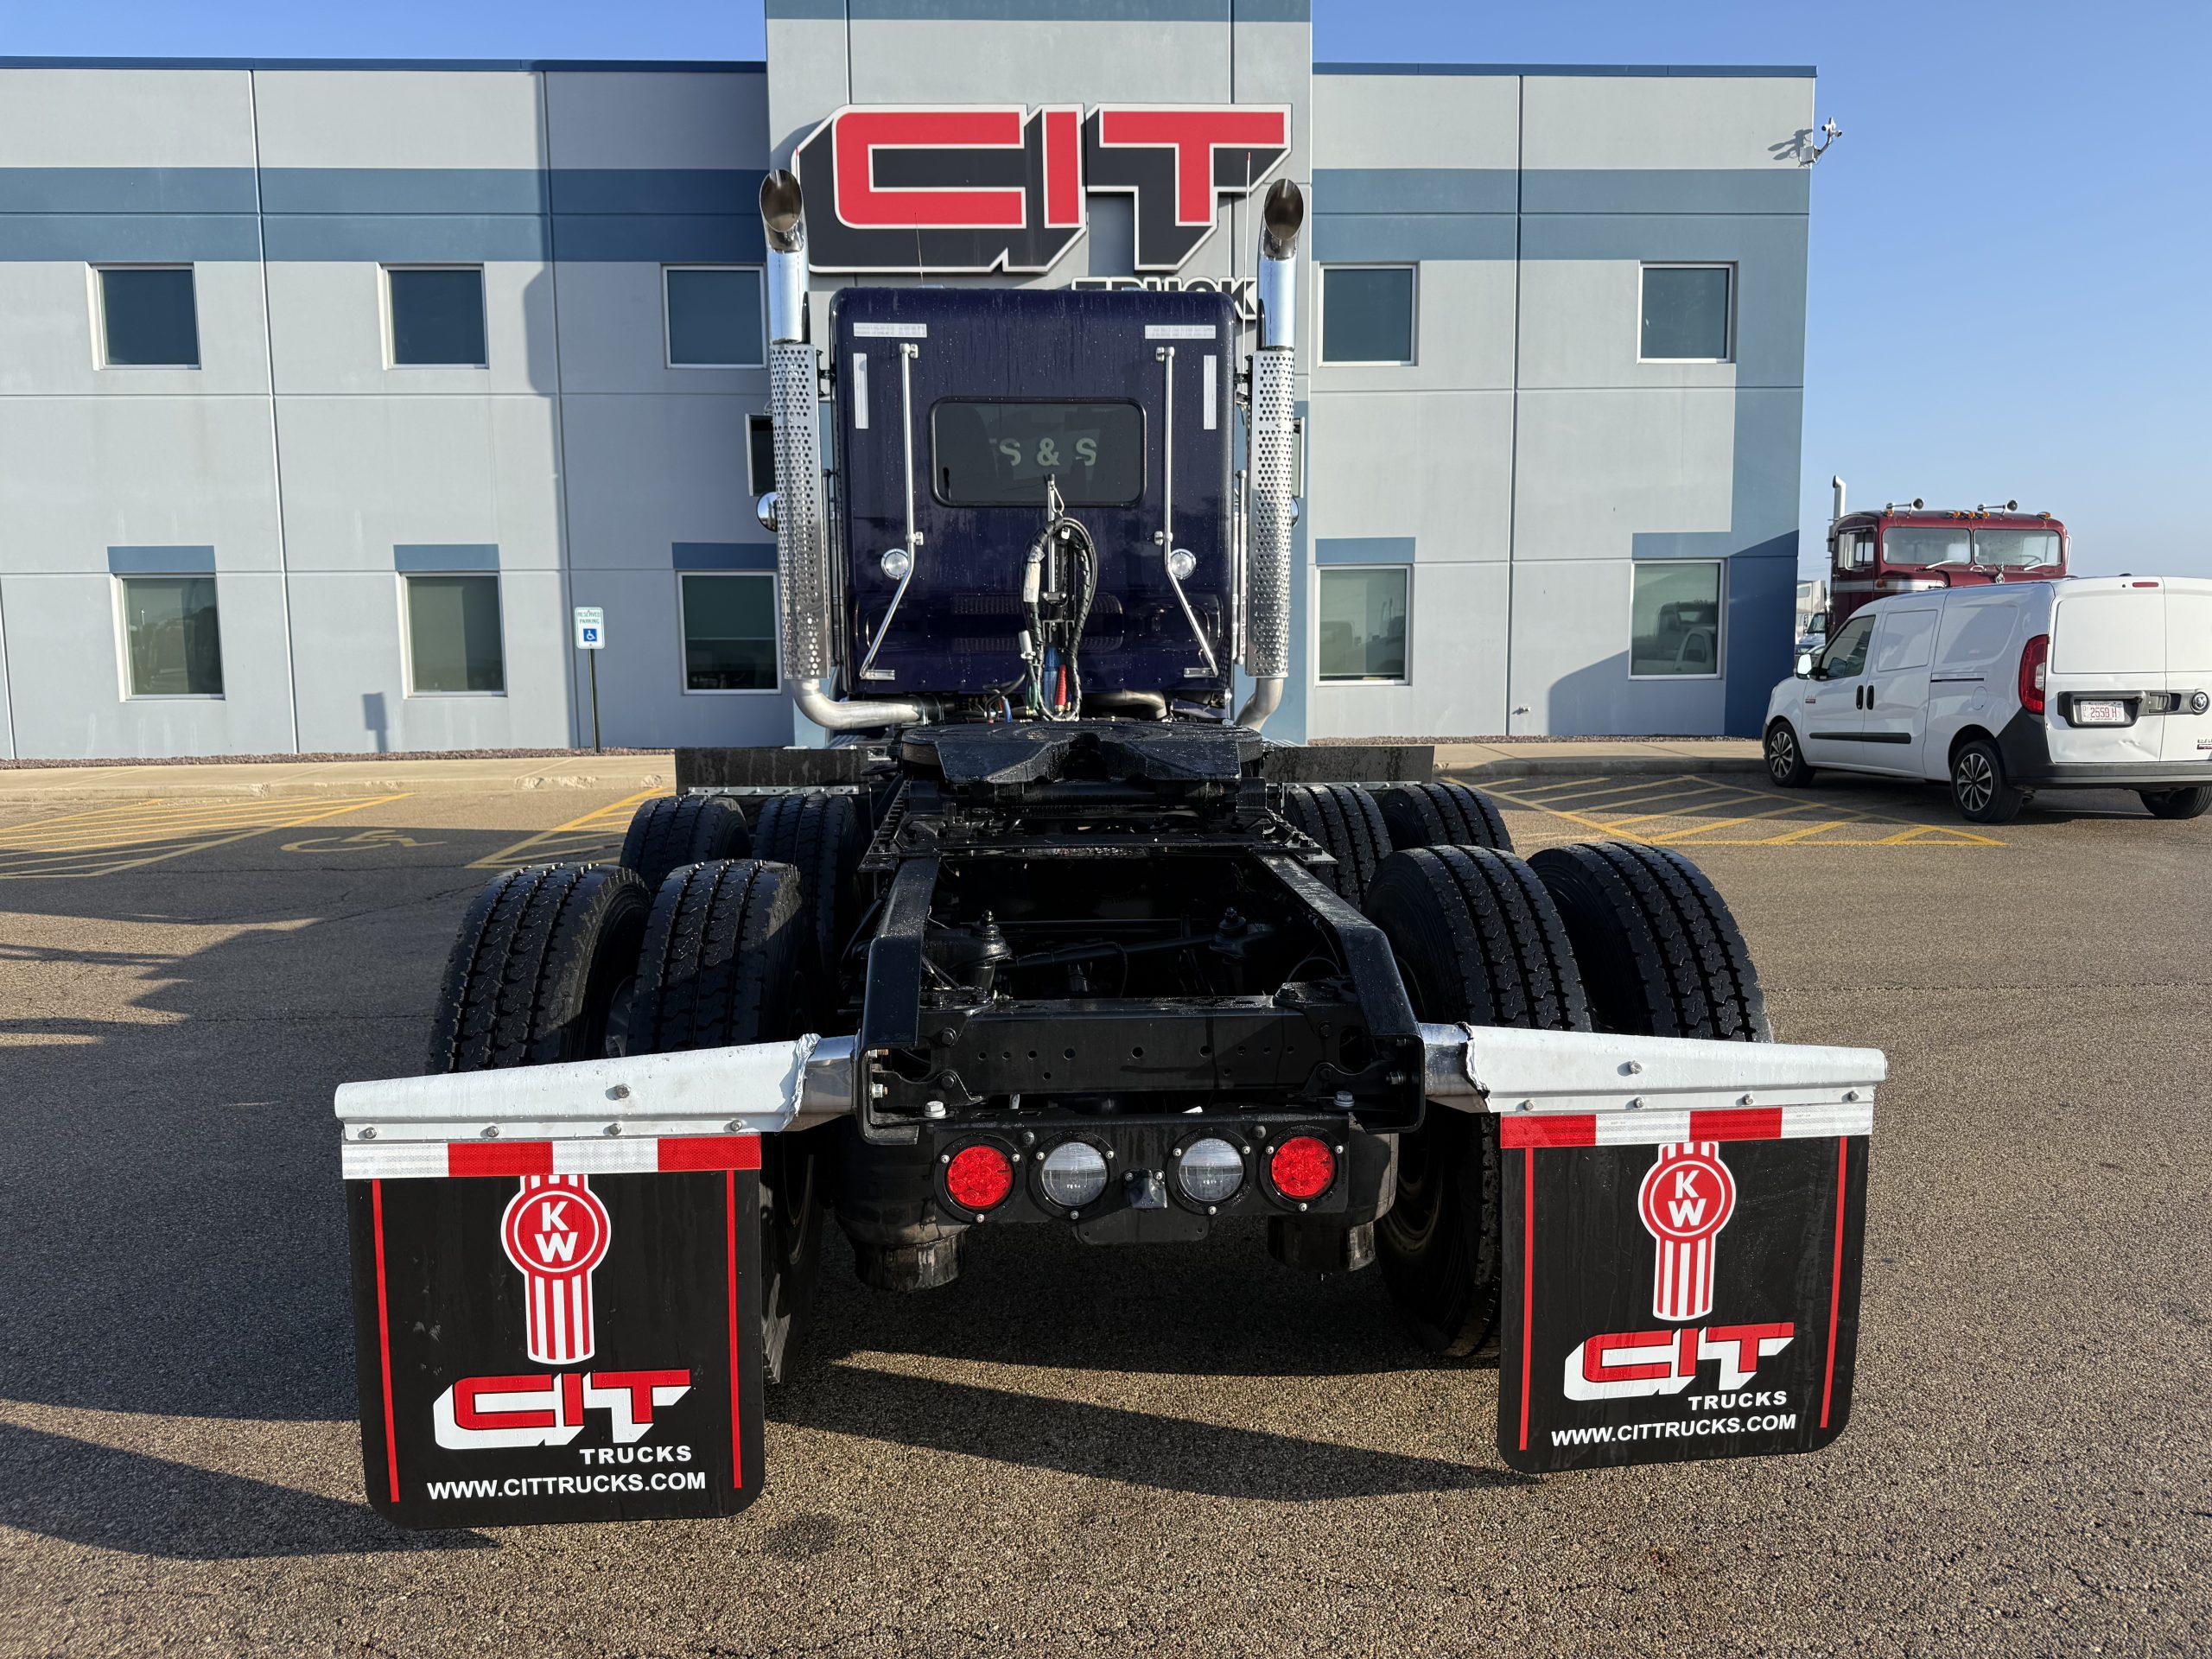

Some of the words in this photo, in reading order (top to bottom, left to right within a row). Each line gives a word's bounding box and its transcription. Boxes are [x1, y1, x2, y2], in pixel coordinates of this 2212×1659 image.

[828, 104, 1293, 232] CIT
[1581, 1321, 1795, 1382] CIT
[452, 1369, 691, 1431] CIT
[1688, 1390, 1787, 1410] TRUCKS
[1551, 1414, 1796, 1446] WWW.CITTRUCKS.COM
[580, 1445, 692, 1465] TRUCKS
[427, 1471, 706, 1500] WWW.CITTRUCKS.COM
